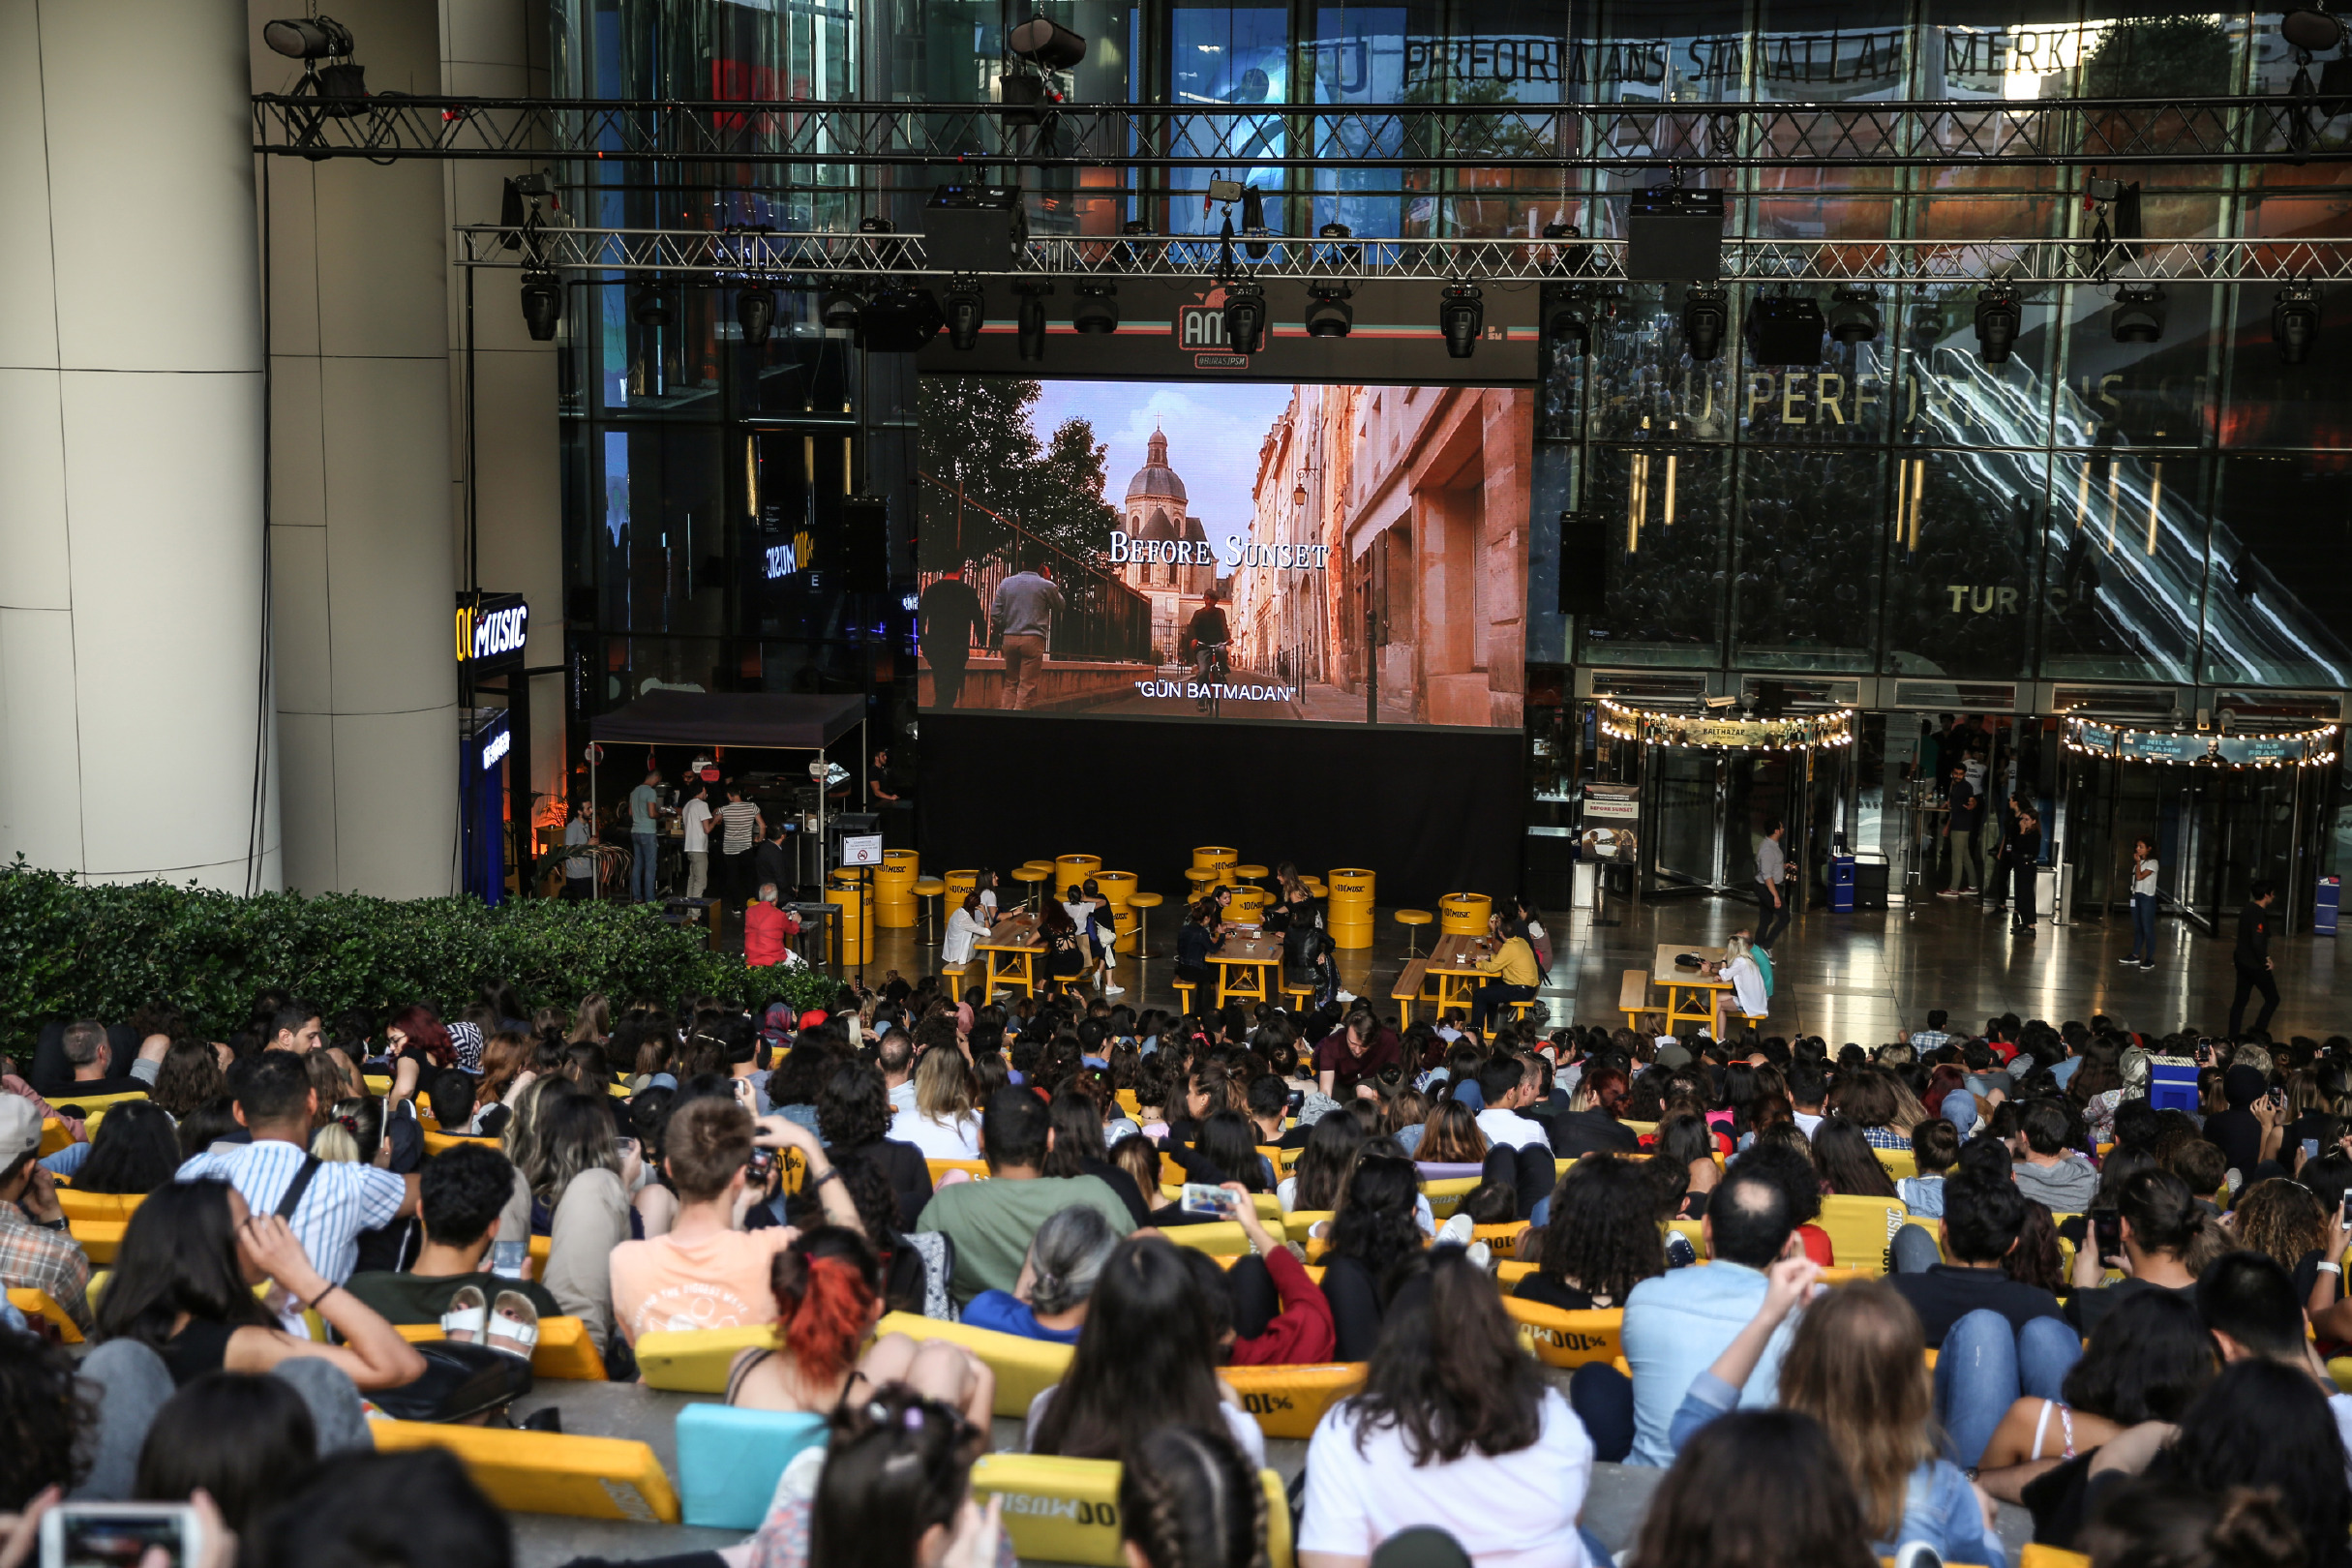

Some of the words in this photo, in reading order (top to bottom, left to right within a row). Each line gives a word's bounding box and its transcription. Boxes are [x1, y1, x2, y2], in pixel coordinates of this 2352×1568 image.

[1109, 530, 1210, 565] BEFORE
[1224, 534, 1330, 569] SUNSET
[1134, 678, 1182, 699] "GÜN
[1187, 682, 1297, 702] BATMADAN"
[2139, 744, 2182, 753] FRAHM
